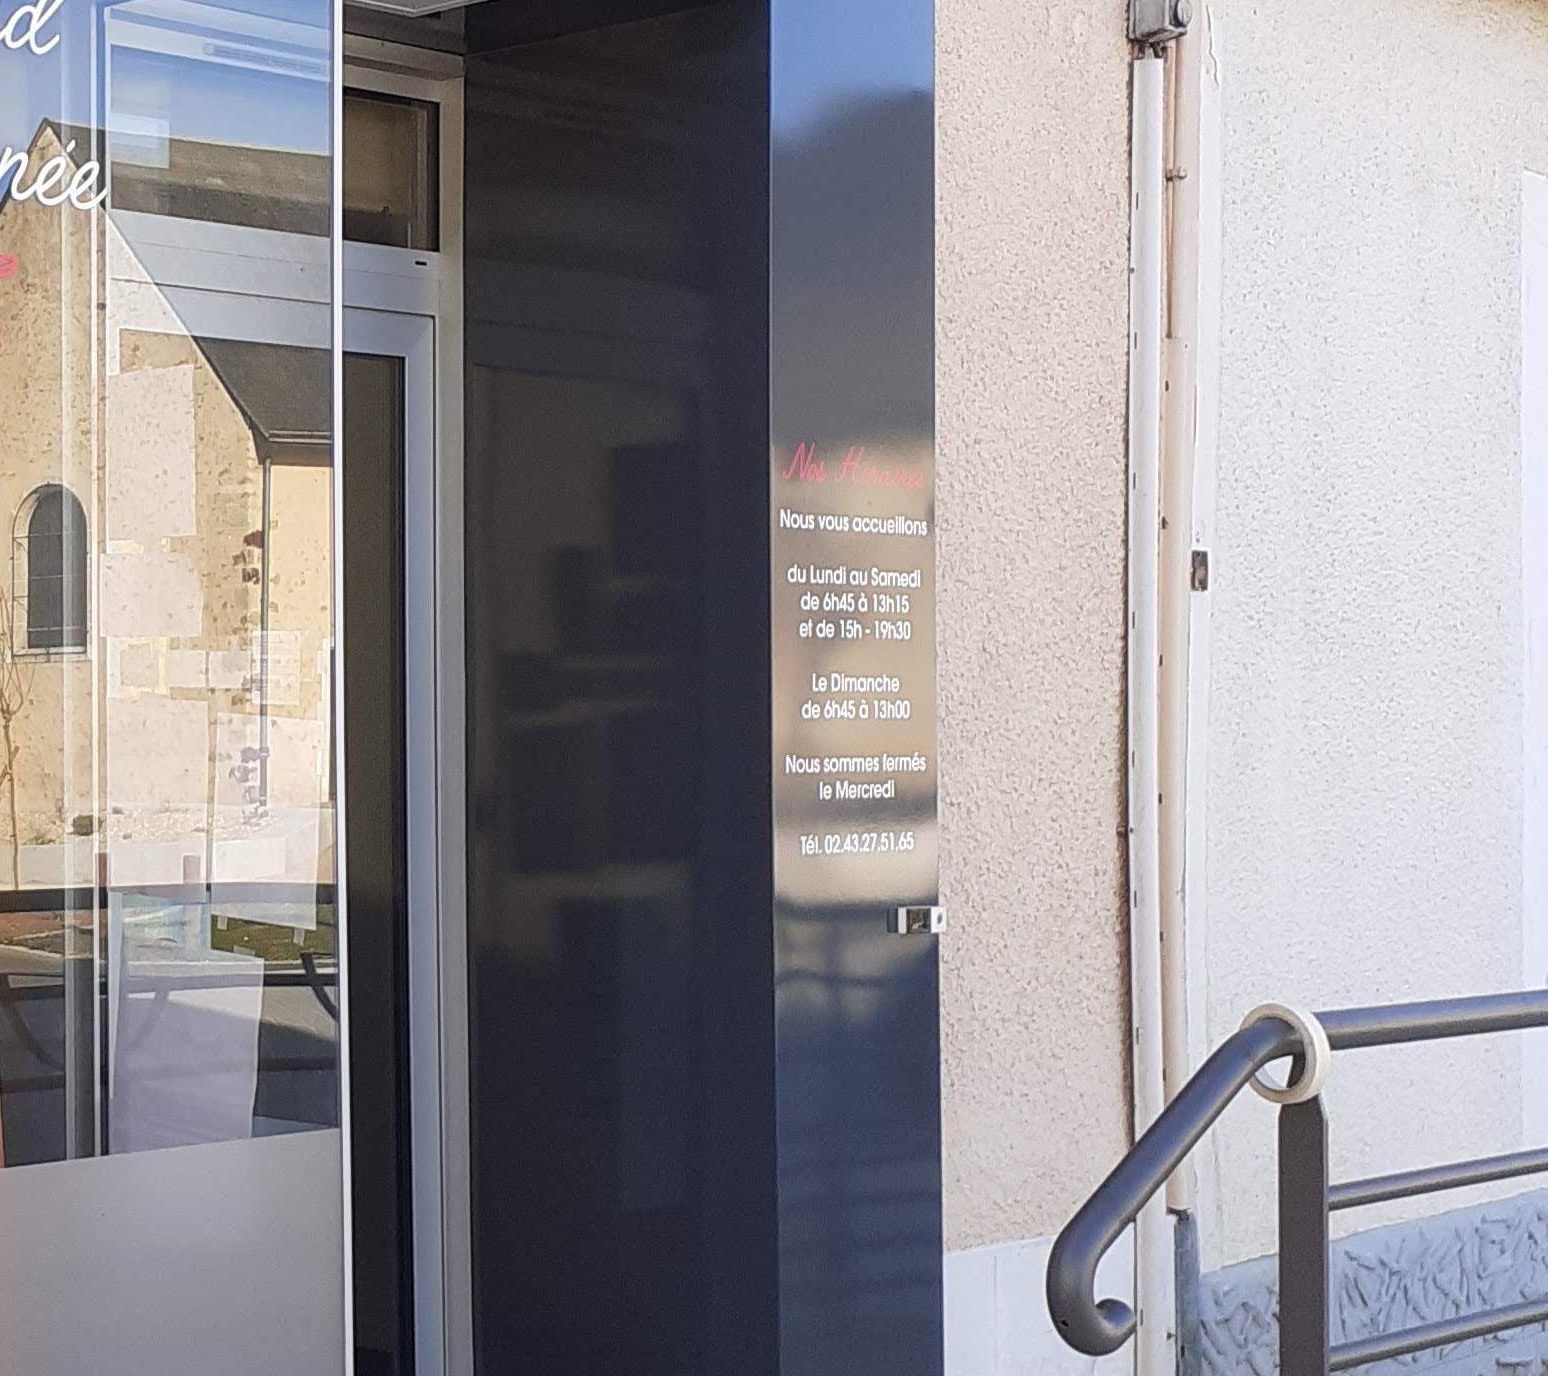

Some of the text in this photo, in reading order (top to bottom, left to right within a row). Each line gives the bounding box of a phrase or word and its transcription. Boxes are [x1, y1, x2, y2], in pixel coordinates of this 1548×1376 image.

[782, 441, 827, 483] Nos
[779, 509, 928, 536] Nous vous accueillons
[787, 564, 921, 587] du Lundi au Samedi
[800, 591, 910, 613] de 6h45 à 13h15
[799, 618, 813, 638] et
[816, 619, 835, 638] de
[839, 619, 863, 639] 15h
[874, 620, 912, 640] 19h30
[811, 672, 900, 692] Le Dimanche
[801, 699, 911, 719] de 6h45 à 13h00
[785, 752, 927, 773] Nous sommes fermés
[819, 780, 896, 800] le Mercredi
[800, 832, 915, 855] Tél. 02.43.27.51.65
